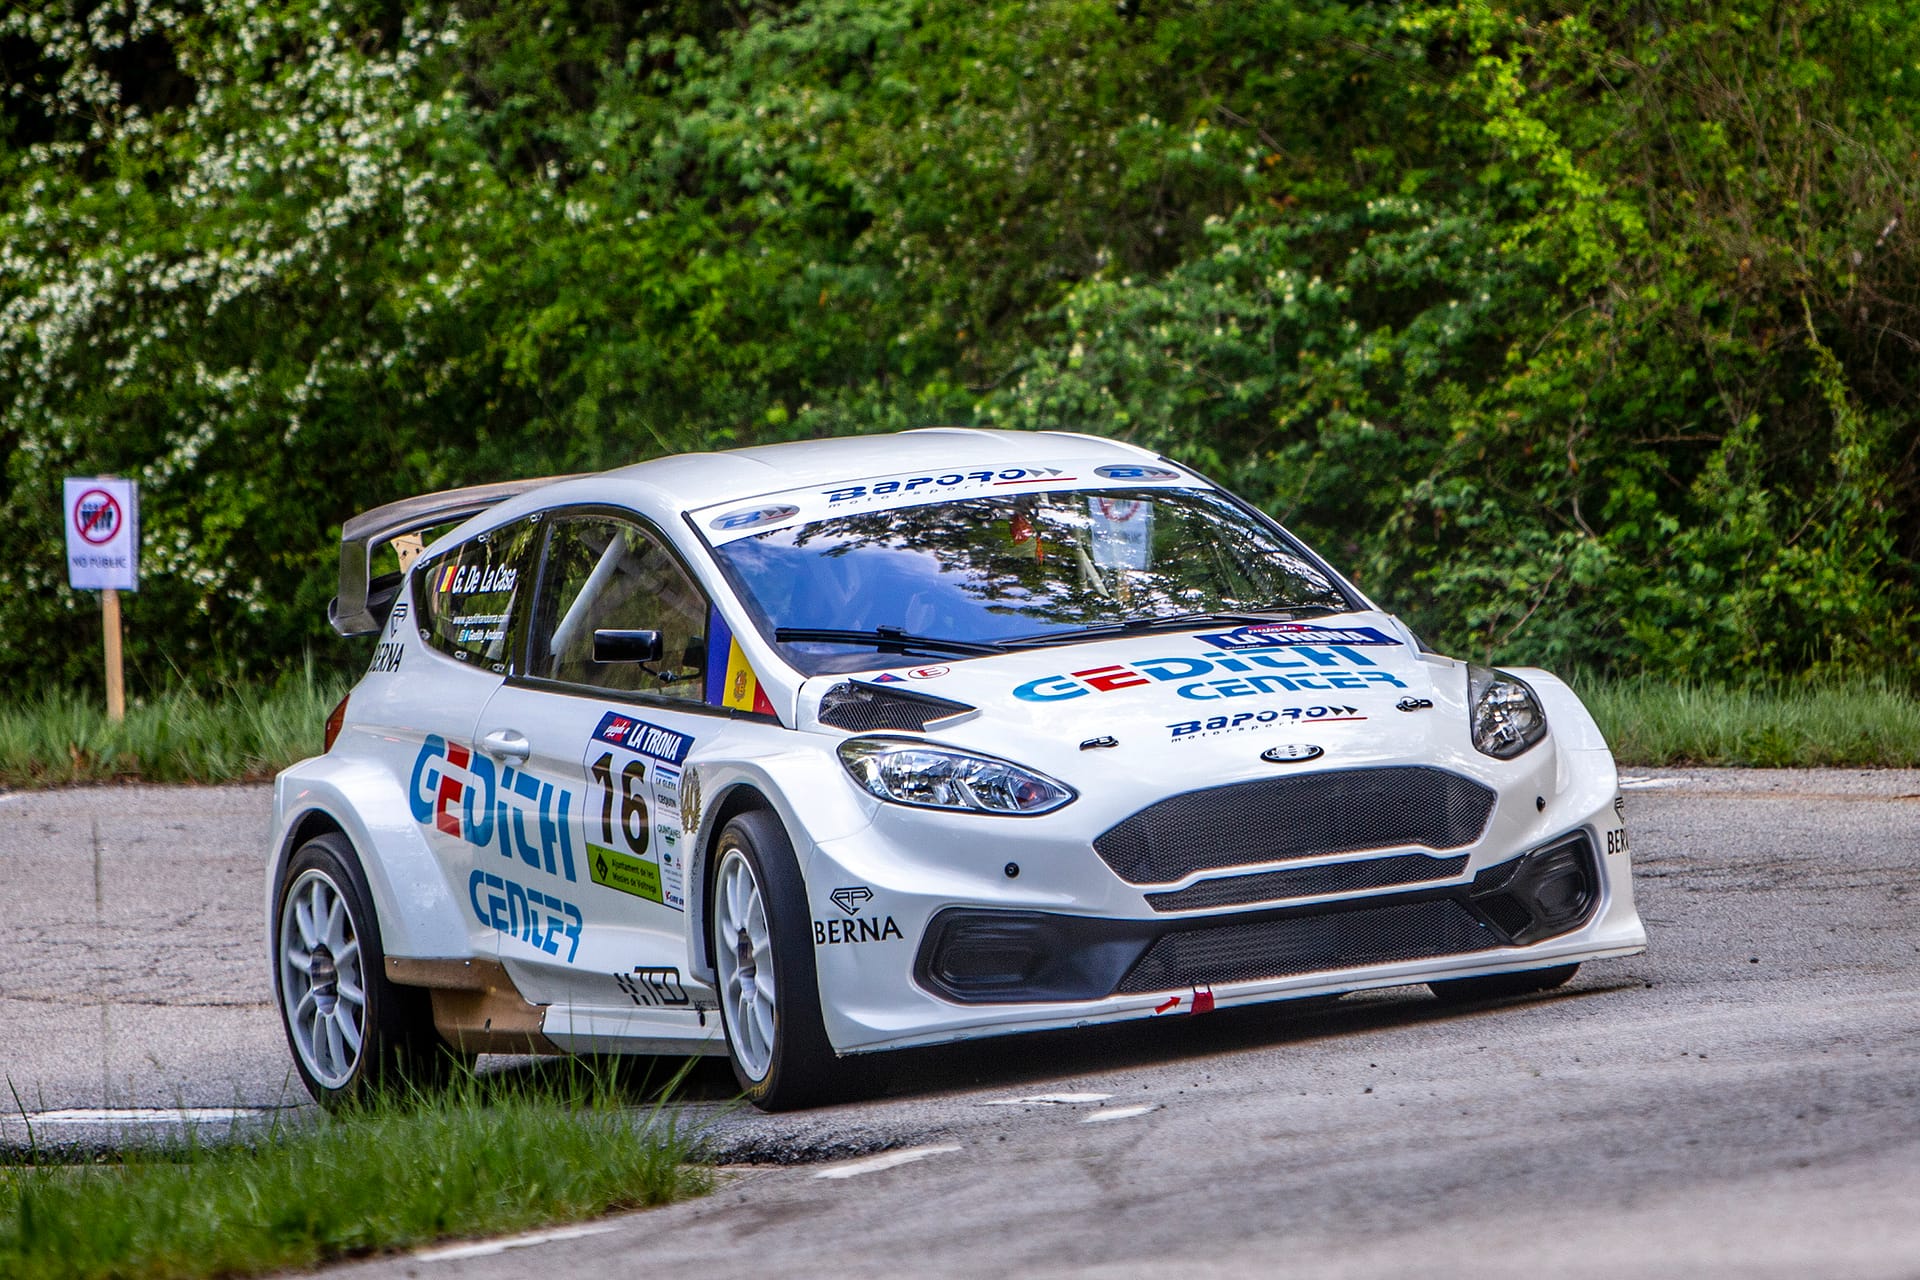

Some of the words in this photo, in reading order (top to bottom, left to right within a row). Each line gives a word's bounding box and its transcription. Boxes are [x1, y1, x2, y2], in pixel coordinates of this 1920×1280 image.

[828, 484, 985, 509] motorsport
[73, 557, 88, 568] NO
[90, 557, 127, 569] PUBLIC
[452, 565, 467, 594] G.
[463, 565, 481, 593] De
[479, 564, 495, 592] La
[493, 563, 517, 592] Casa
[1220, 634, 1270, 645] LA
[1260, 631, 1376, 644] TRONA
[1177, 671, 1409, 701] CENTER
[627, 723, 649, 749] LA
[642, 728, 682, 761] TRONA
[1171, 721, 1295, 743] motorsport
[591, 752, 649, 855] 16
[469, 870, 583, 964] CENTER
[813, 916, 904, 945] BERNA
